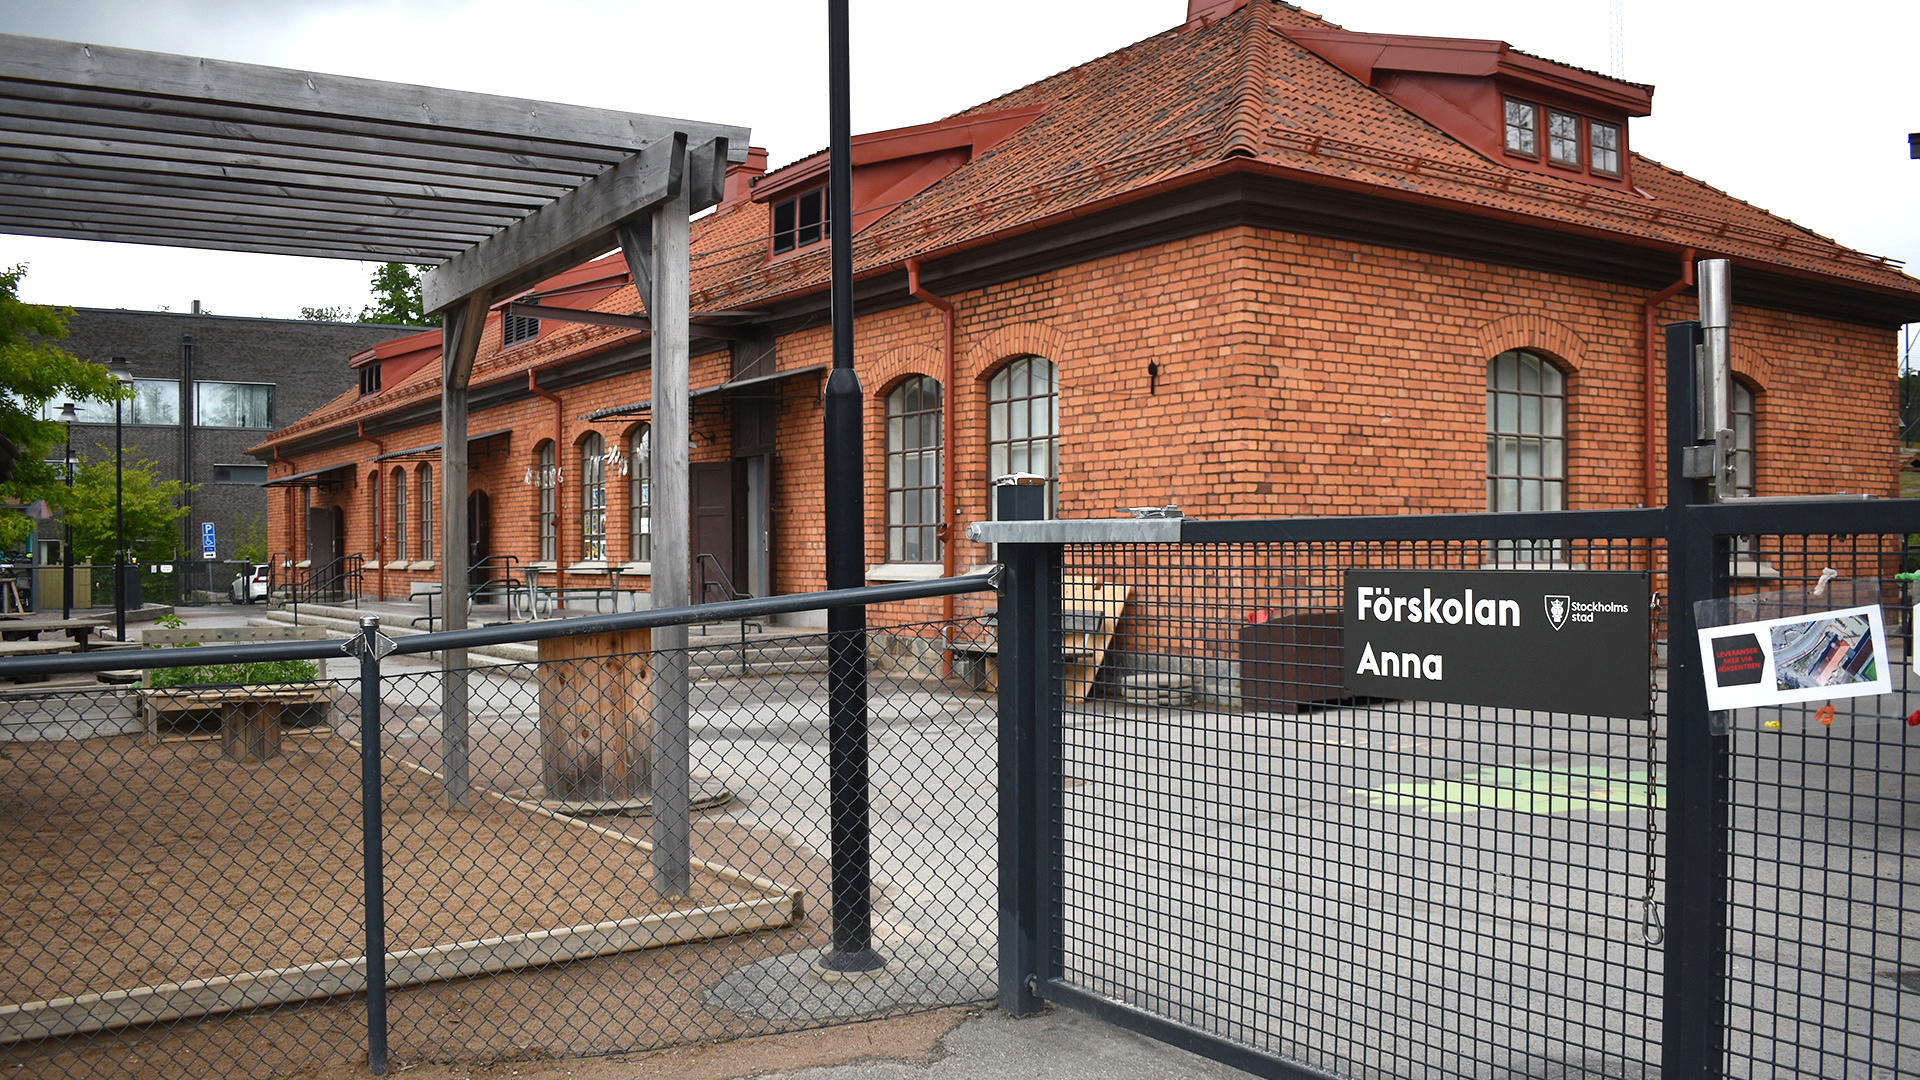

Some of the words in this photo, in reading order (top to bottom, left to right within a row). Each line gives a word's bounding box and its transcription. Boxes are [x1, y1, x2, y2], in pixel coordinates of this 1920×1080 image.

[205, 524, 212, 534] P
[1357, 586, 1521, 627] Förskolan
[1571, 601, 1629, 613] Stockholms
[1571, 612, 1594, 623] stad
[1716, 647, 1758, 658] LEVERANSER
[1356, 641, 1443, 681] Anna
